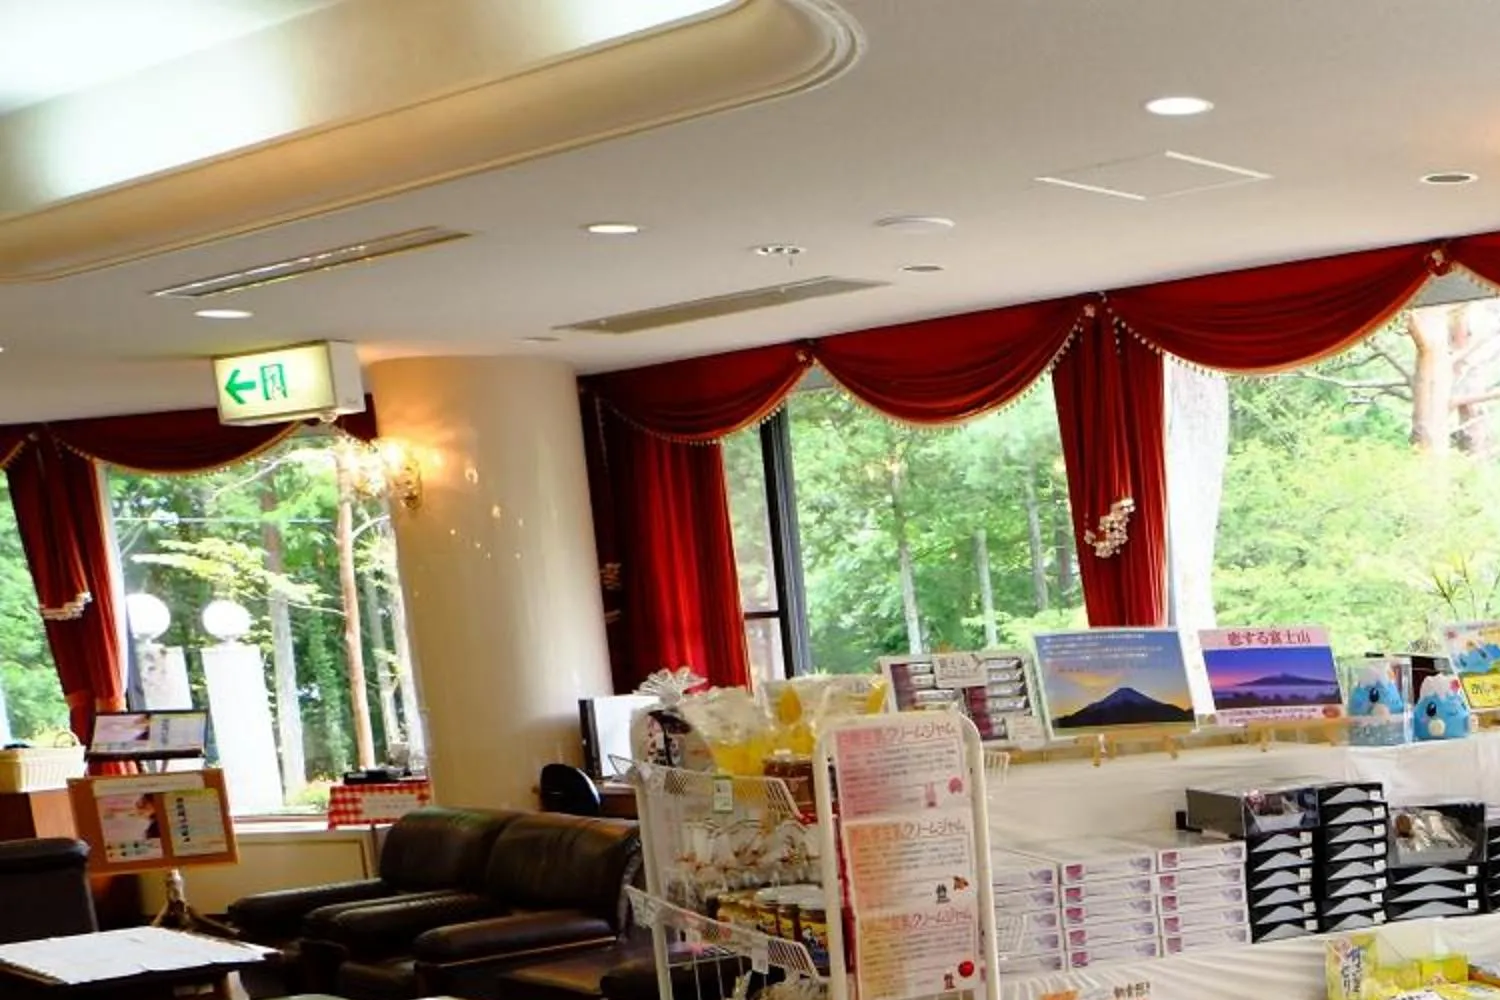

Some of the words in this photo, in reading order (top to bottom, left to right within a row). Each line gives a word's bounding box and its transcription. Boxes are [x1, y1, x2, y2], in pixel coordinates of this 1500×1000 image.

[1228, 630, 1311, 646] 恋する富士山
